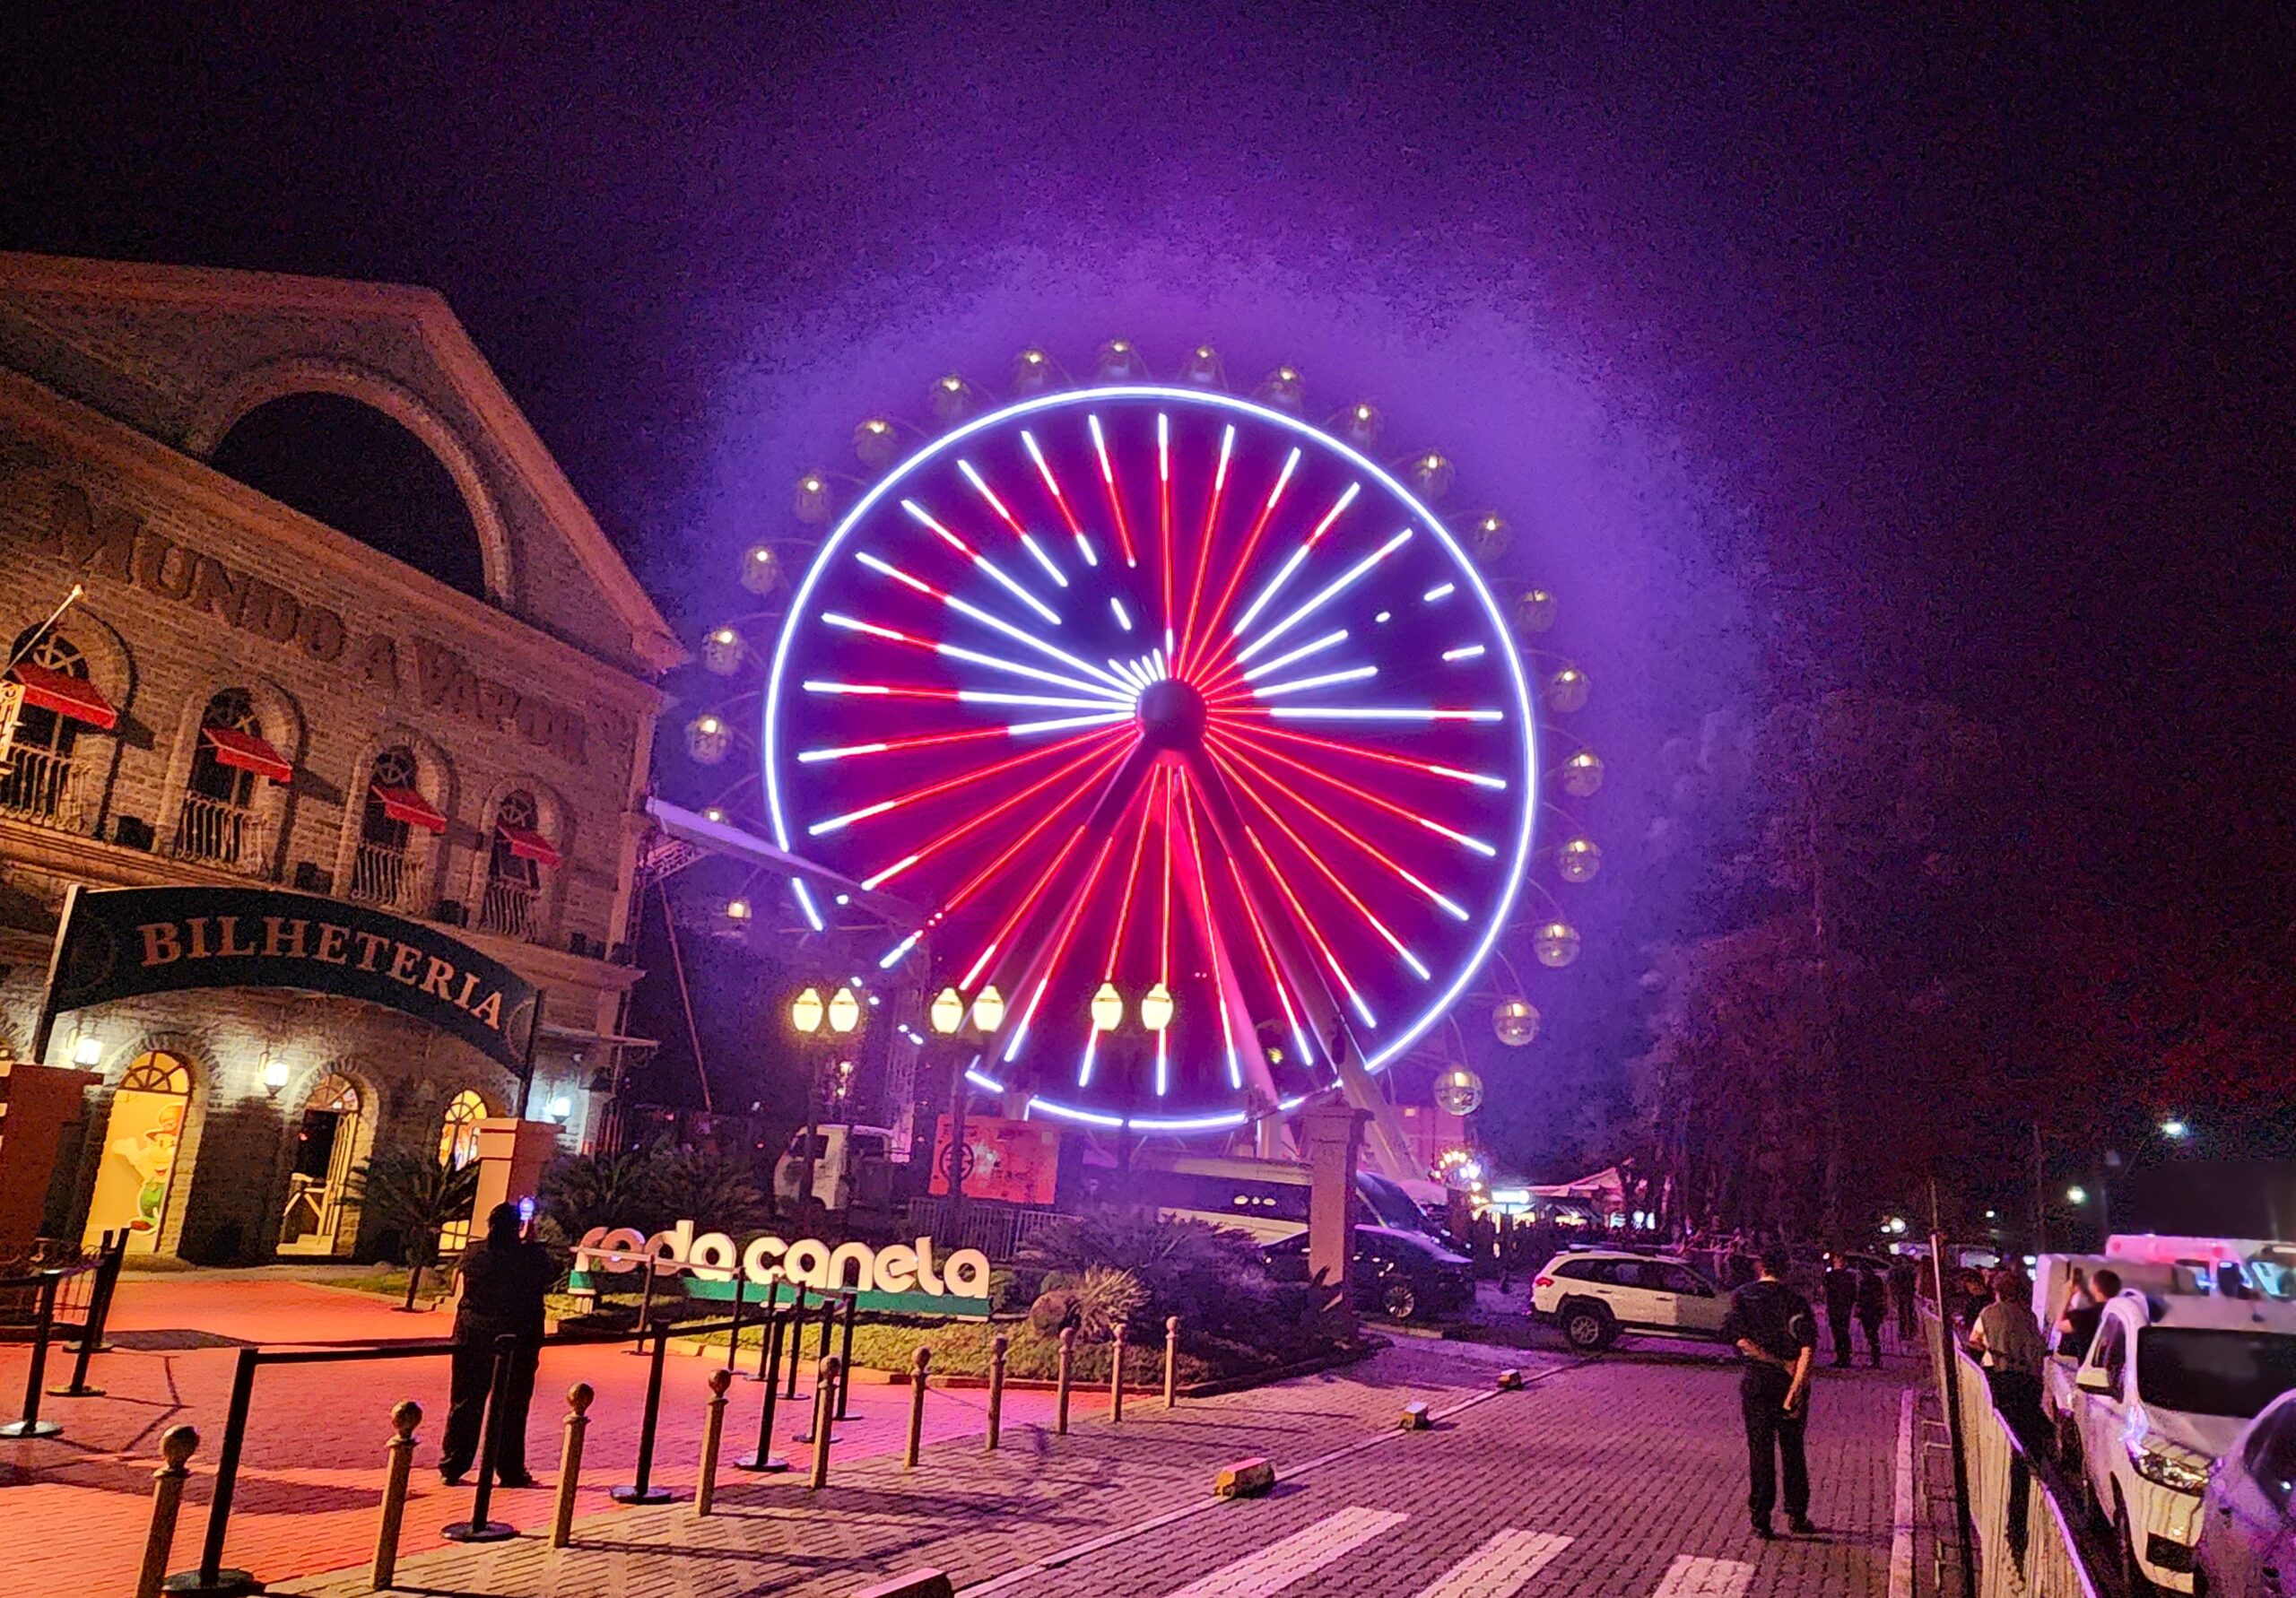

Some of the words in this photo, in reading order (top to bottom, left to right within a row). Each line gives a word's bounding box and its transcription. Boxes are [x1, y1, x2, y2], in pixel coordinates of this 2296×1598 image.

[137, 916, 502, 1030] BILHETERIA
[575, 1220, 736, 1282] roda
[744, 1236, 991, 1298] canela
